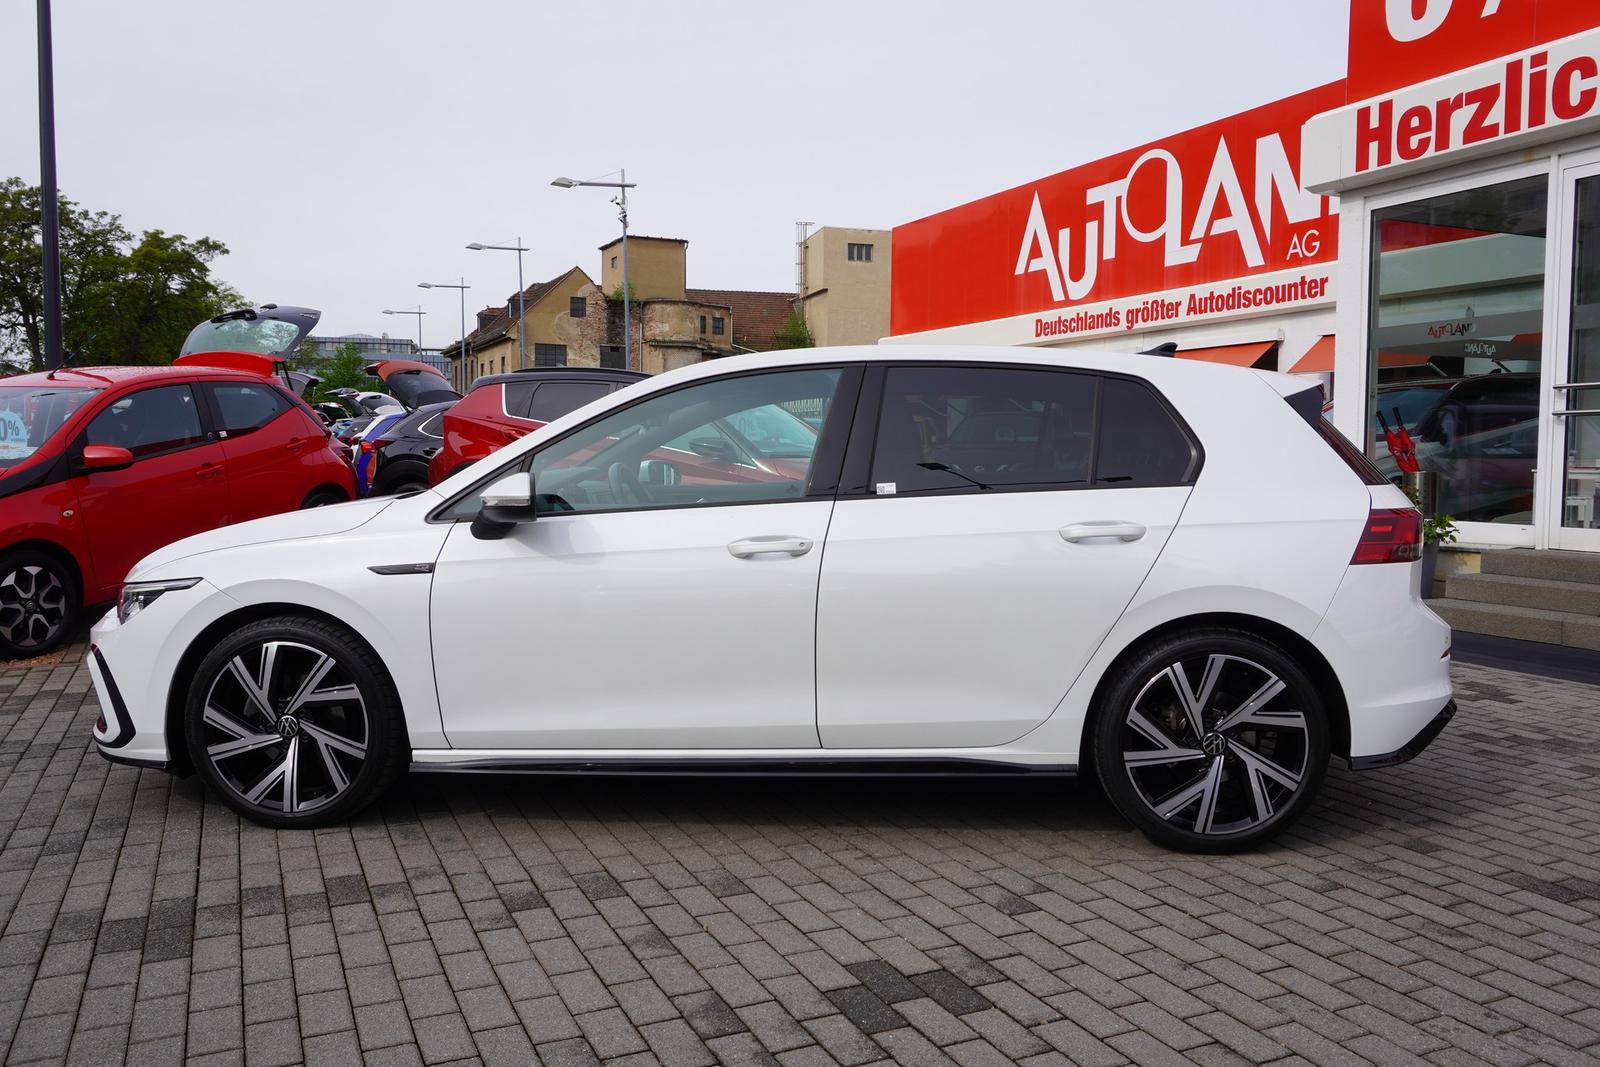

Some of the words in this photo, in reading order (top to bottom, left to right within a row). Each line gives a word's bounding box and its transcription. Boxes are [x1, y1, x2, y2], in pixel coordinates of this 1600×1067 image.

[1355, 50, 1599, 173] Herzlic
[1014, 132, 1340, 302] AUTOLAN
[1286, 229, 1320, 261] AG
[1035, 307, 1121, 337] Deutschlands
[1126, 299, 1182, 330] größter
[1186, 275, 1329, 316] Autodiscounter
